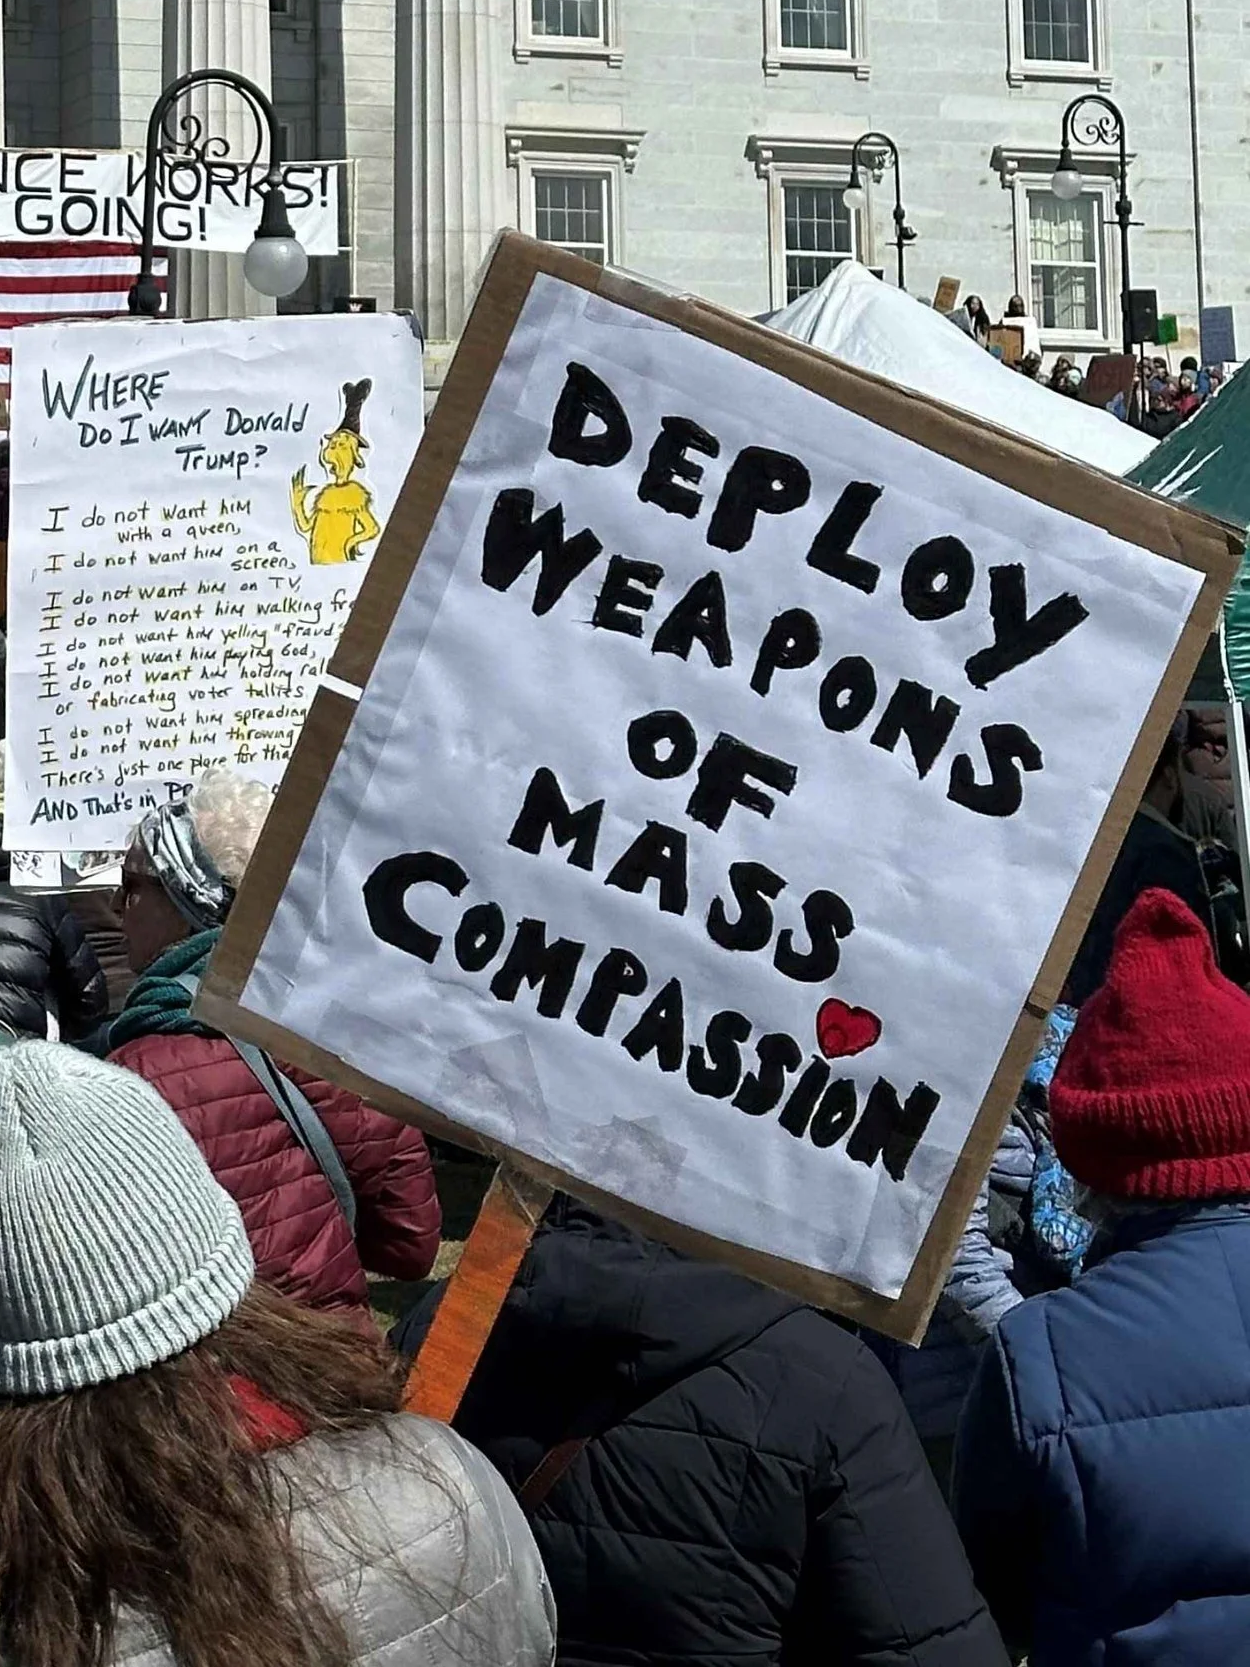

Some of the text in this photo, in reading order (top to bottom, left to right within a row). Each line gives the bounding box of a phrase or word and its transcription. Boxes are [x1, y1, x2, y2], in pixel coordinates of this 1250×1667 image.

[15, 194, 206, 241] GOING!
[42, 354, 170, 420] WHERE
[78, 423, 112, 448] Do
[119, 413, 142, 445] I
[41, 506, 70, 532] I
[82, 503, 105, 528] do
[115, 500, 150, 523] not
[118, 524, 241, 543] with a queen,
[546, 359, 1091, 690] DEPLOY
[43, 554, 66, 573] I
[74, 552, 96, 568] do
[105, 551, 137, 567] not
[148, 547, 187, 564] want
[236, 542, 258, 554] on
[268, 541, 281, 552] a
[230, 556, 297, 571] screen,
[41, 591, 62, 611] I
[73, 590, 94, 605] do
[102, 585, 132, 602] not
[139, 582, 187, 600] want
[240, 582, 258, 591] on
[268, 576, 302, 592] TV,
[39, 616, 62, 632] I
[74, 613, 97, 627] do
[108, 608, 140, 623] not
[154, 604, 203, 622] want
[257, 598, 323, 624] walking
[36, 643, 56, 657] I
[66, 638, 86, 652] do
[98, 633, 124, 647] not
[135, 628, 177, 644] want
[221, 624, 267, 649] yelling
[481, 487, 1045, 818] WEAPONS
[38, 662, 58, 677] I
[67, 658, 86, 671] do
[99, 652, 131, 668] not
[141, 649, 182, 664] want
[37, 682, 61, 699] I
[70, 675, 92, 690] do
[104, 670, 132, 685] not
[145, 666, 192, 683] want
[241, 664, 292, 689] holding
[56, 702, 74, 715] or
[87, 689, 176, 711] fabricating
[189, 686, 233, 699] voter
[38, 728, 55, 745] I
[70, 726, 88, 739] do
[103, 719, 132, 734] not
[146, 713, 186, 730] want
[234, 705, 307, 726] spreading
[39, 751, 59, 764] I
[70, 746, 88, 759] do
[101, 739, 127, 754] not
[139, 734, 180, 751] want
[226, 727, 294, 748] throwing
[41, 766, 104, 788] There's
[114, 760, 150, 786] just
[158, 760, 184, 771] one
[234, 744, 258, 764] for
[626, 708, 798, 835] OF
[30, 796, 78, 825] AND
[83, 791, 133, 816] That's
[506, 765, 855, 984] MASS
[362, 849, 941, 1182] COMPASSION
